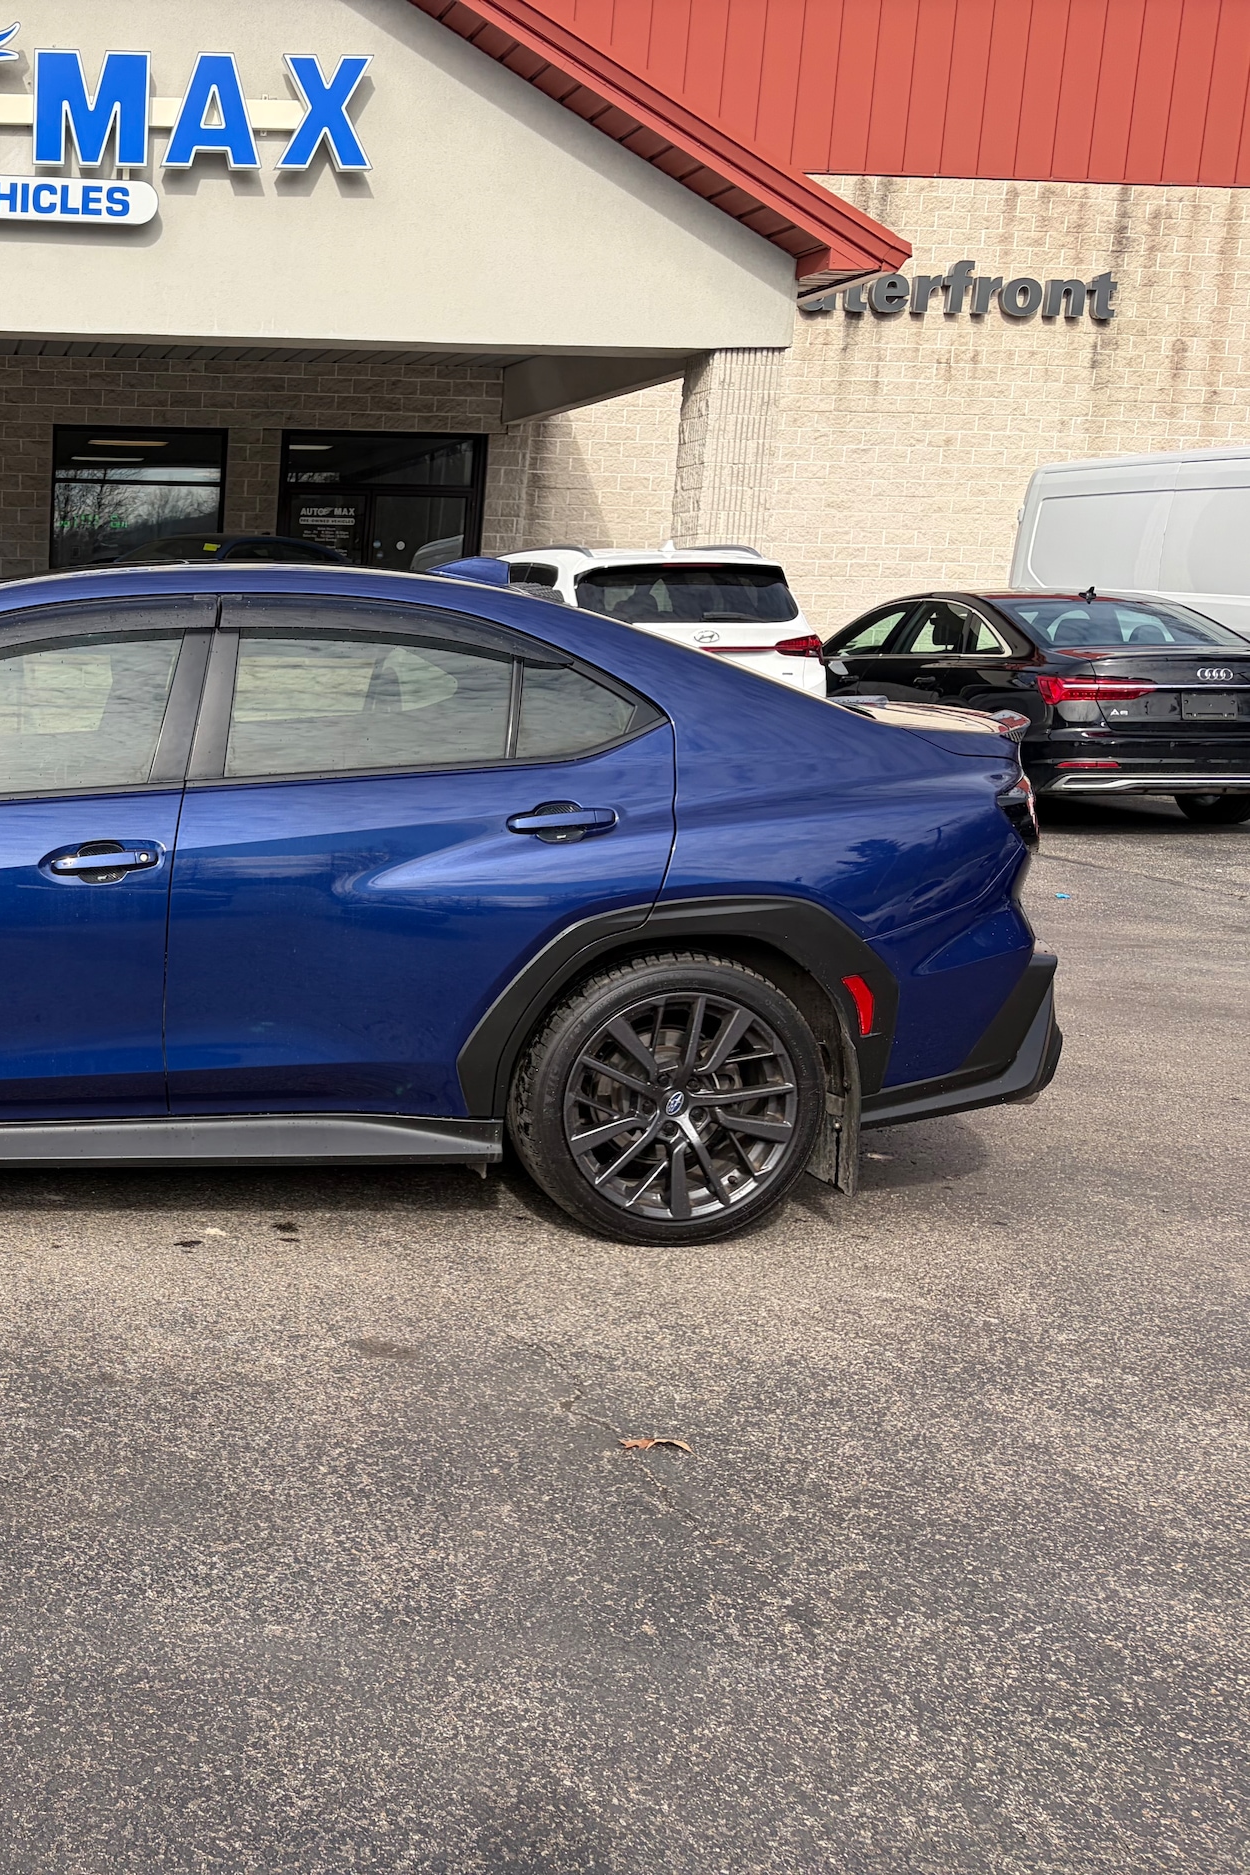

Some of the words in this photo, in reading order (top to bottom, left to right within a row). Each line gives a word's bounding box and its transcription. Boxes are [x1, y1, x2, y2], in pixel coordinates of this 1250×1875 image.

[32, 49, 374, 171] MAX
[798, 260, 1118, 320] terfront
[300, 508, 326, 516] AUTO
[334, 508, 355, 516] MAX
